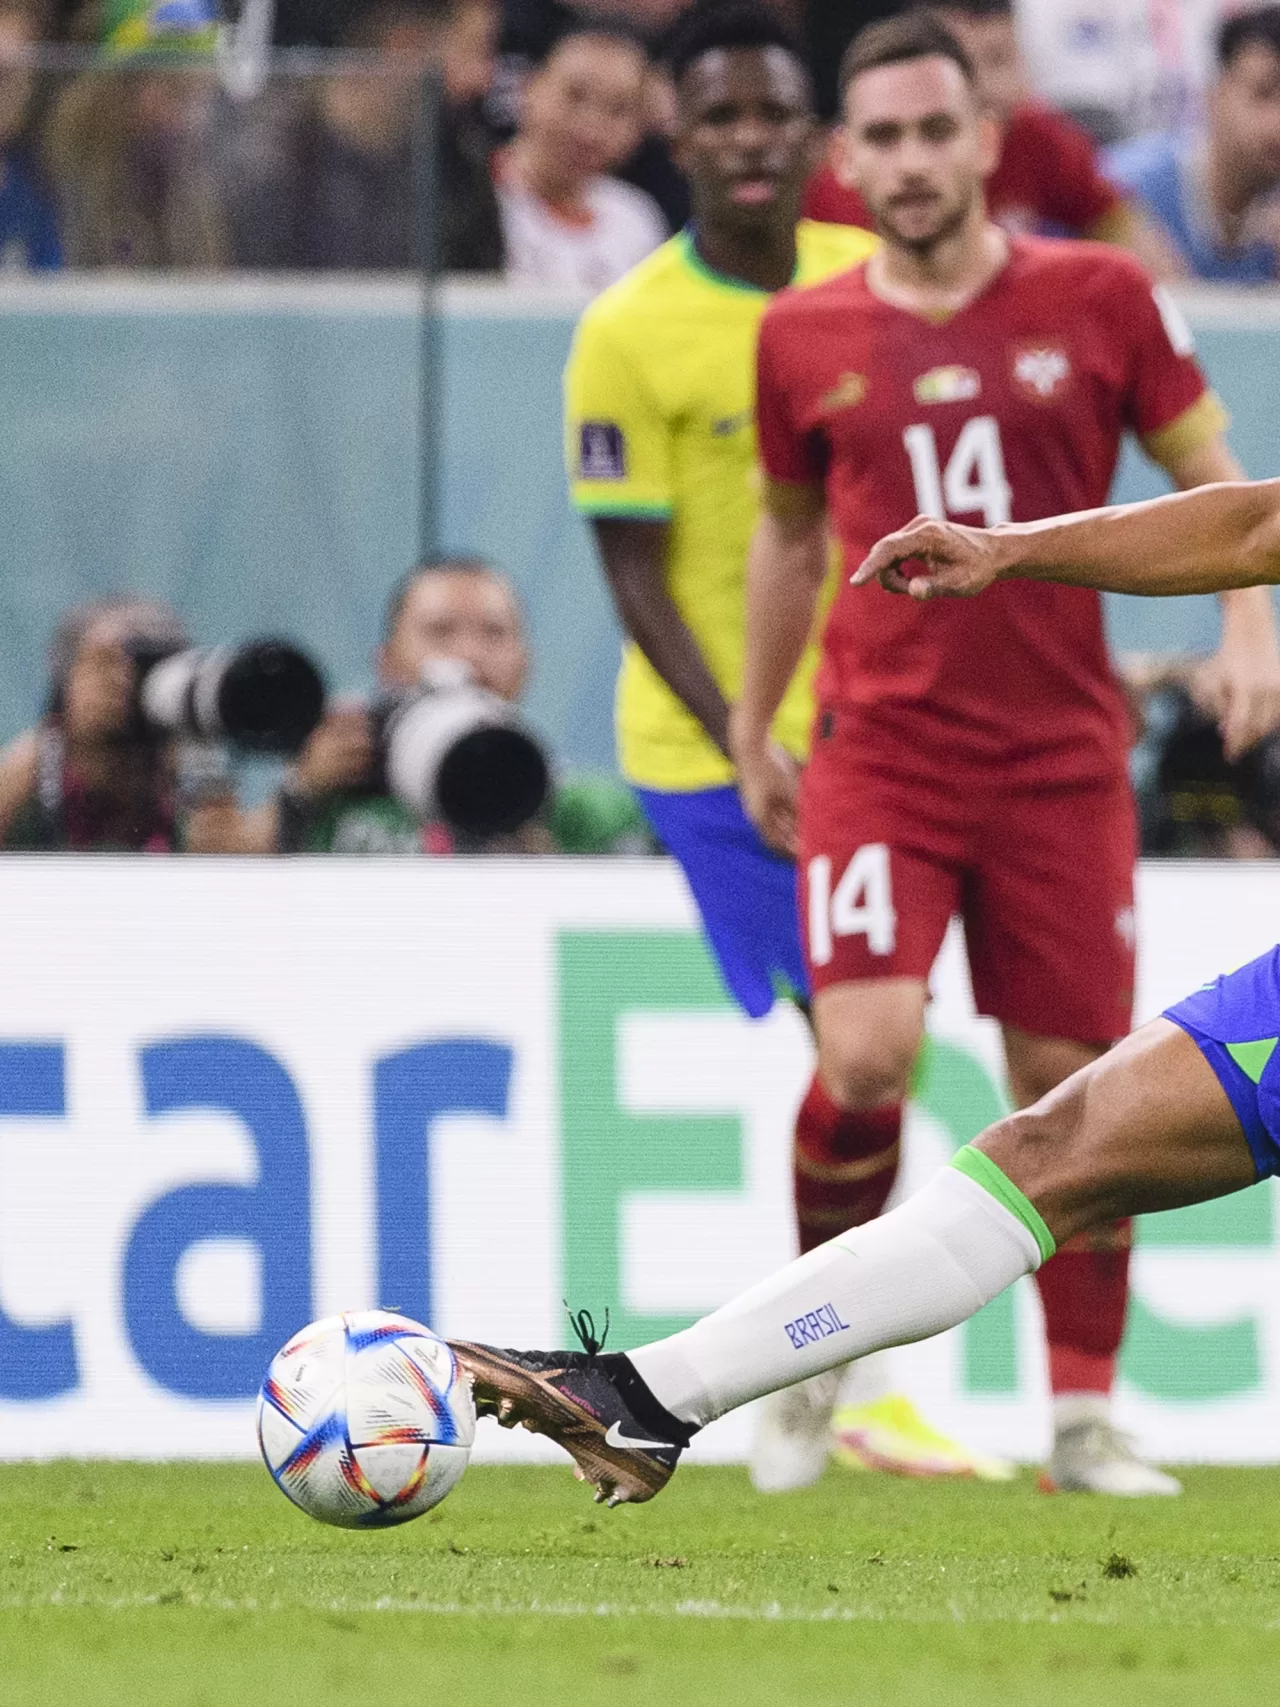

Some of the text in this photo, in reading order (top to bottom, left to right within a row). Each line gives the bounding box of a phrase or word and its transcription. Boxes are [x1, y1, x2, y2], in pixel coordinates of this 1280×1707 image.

[903, 415, 1012, 528] 14
[807, 842, 895, 966] 14
[785, 1303, 850, 1349] BRASIL
